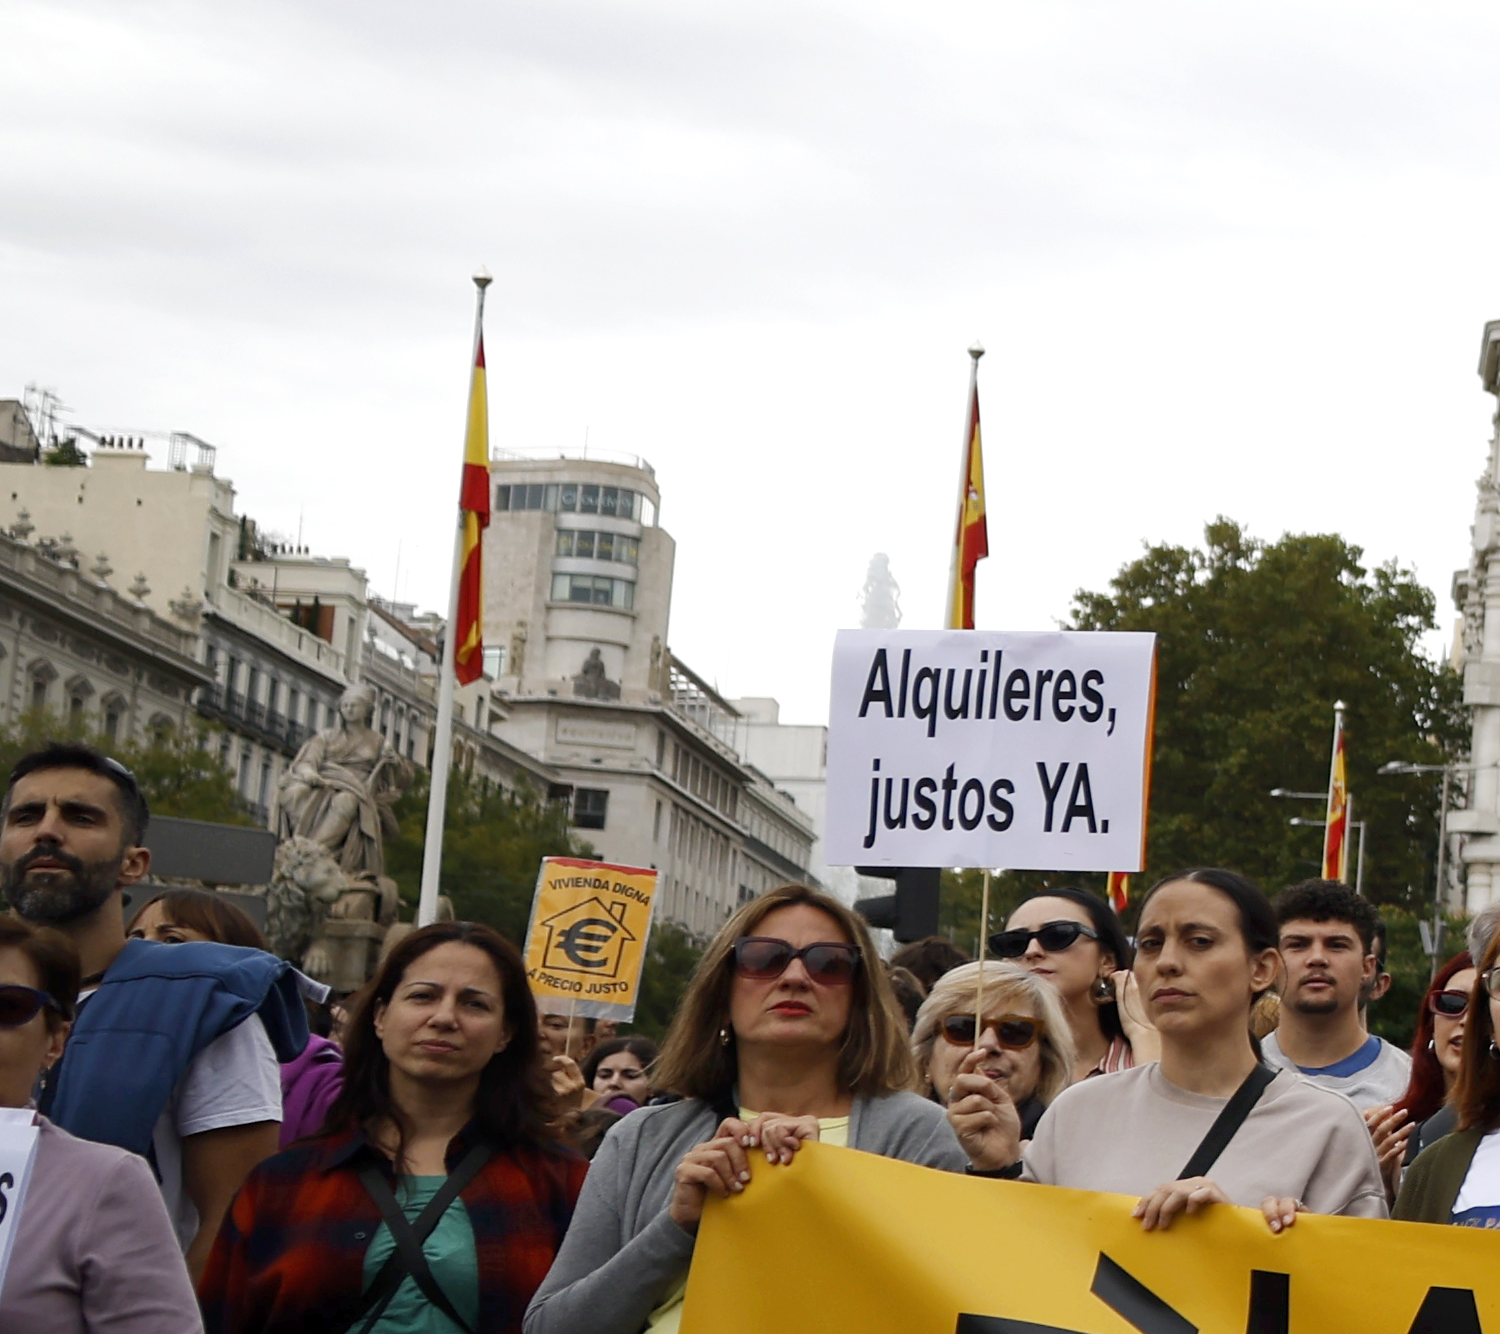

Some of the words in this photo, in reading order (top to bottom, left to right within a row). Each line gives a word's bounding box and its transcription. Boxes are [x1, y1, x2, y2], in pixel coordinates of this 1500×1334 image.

[858, 648, 1116, 738] Alquileres,
[863, 758, 1015, 849] justos
[1035, 761, 1110, 834] YA.
[548, 877, 610, 892] VIVIENDA
[612, 882, 651, 907] DIGNA
[527, 968, 536, 980] A
[537, 971, 583, 993] PRECIO
[585, 981, 629, 994] JUSTO
